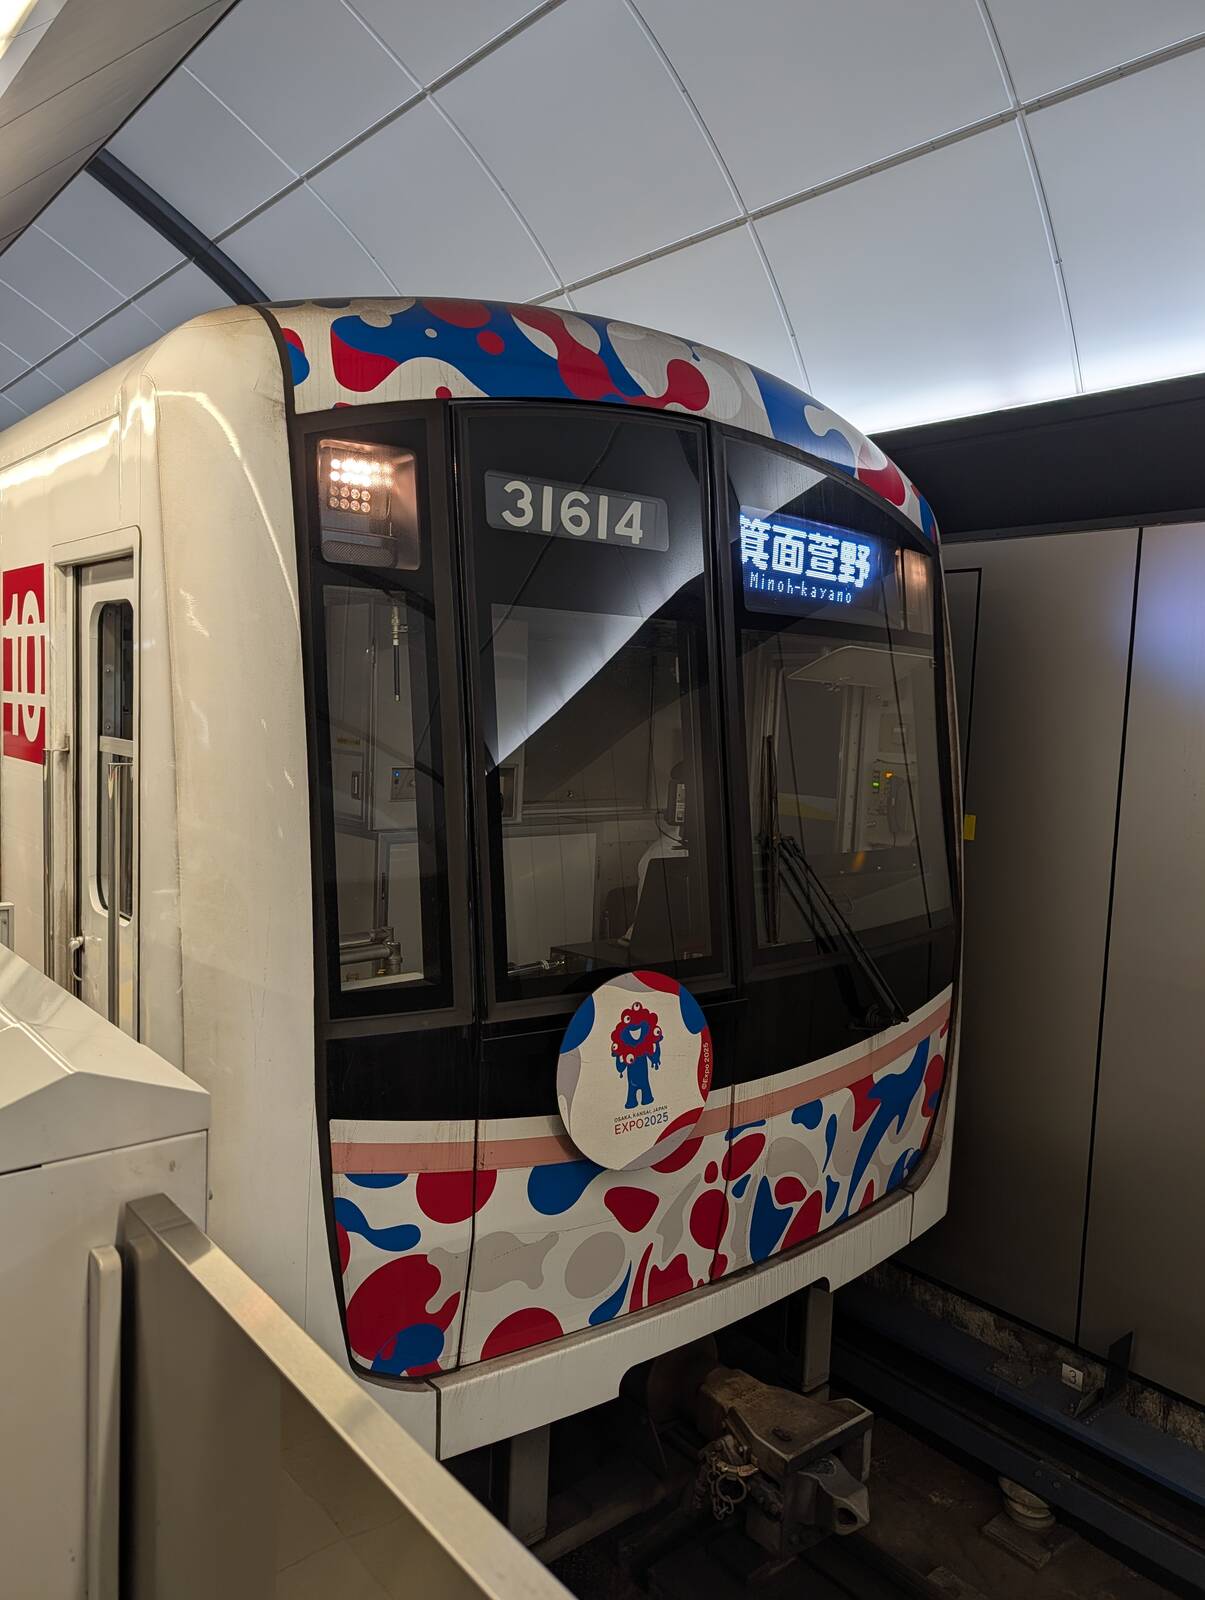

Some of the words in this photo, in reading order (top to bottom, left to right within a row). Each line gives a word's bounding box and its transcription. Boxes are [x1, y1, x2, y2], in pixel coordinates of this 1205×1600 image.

[501, 480, 643, 545] 31614
[740, 514, 870, 588] 箕面萱野
[749, 571, 852, 604] Minoh-kayano
[613, 1114, 632, 1123] OSAKA,
[652, 1105, 668, 1113] JAPAN
[614, 1111, 669, 1135] EXPO2025
